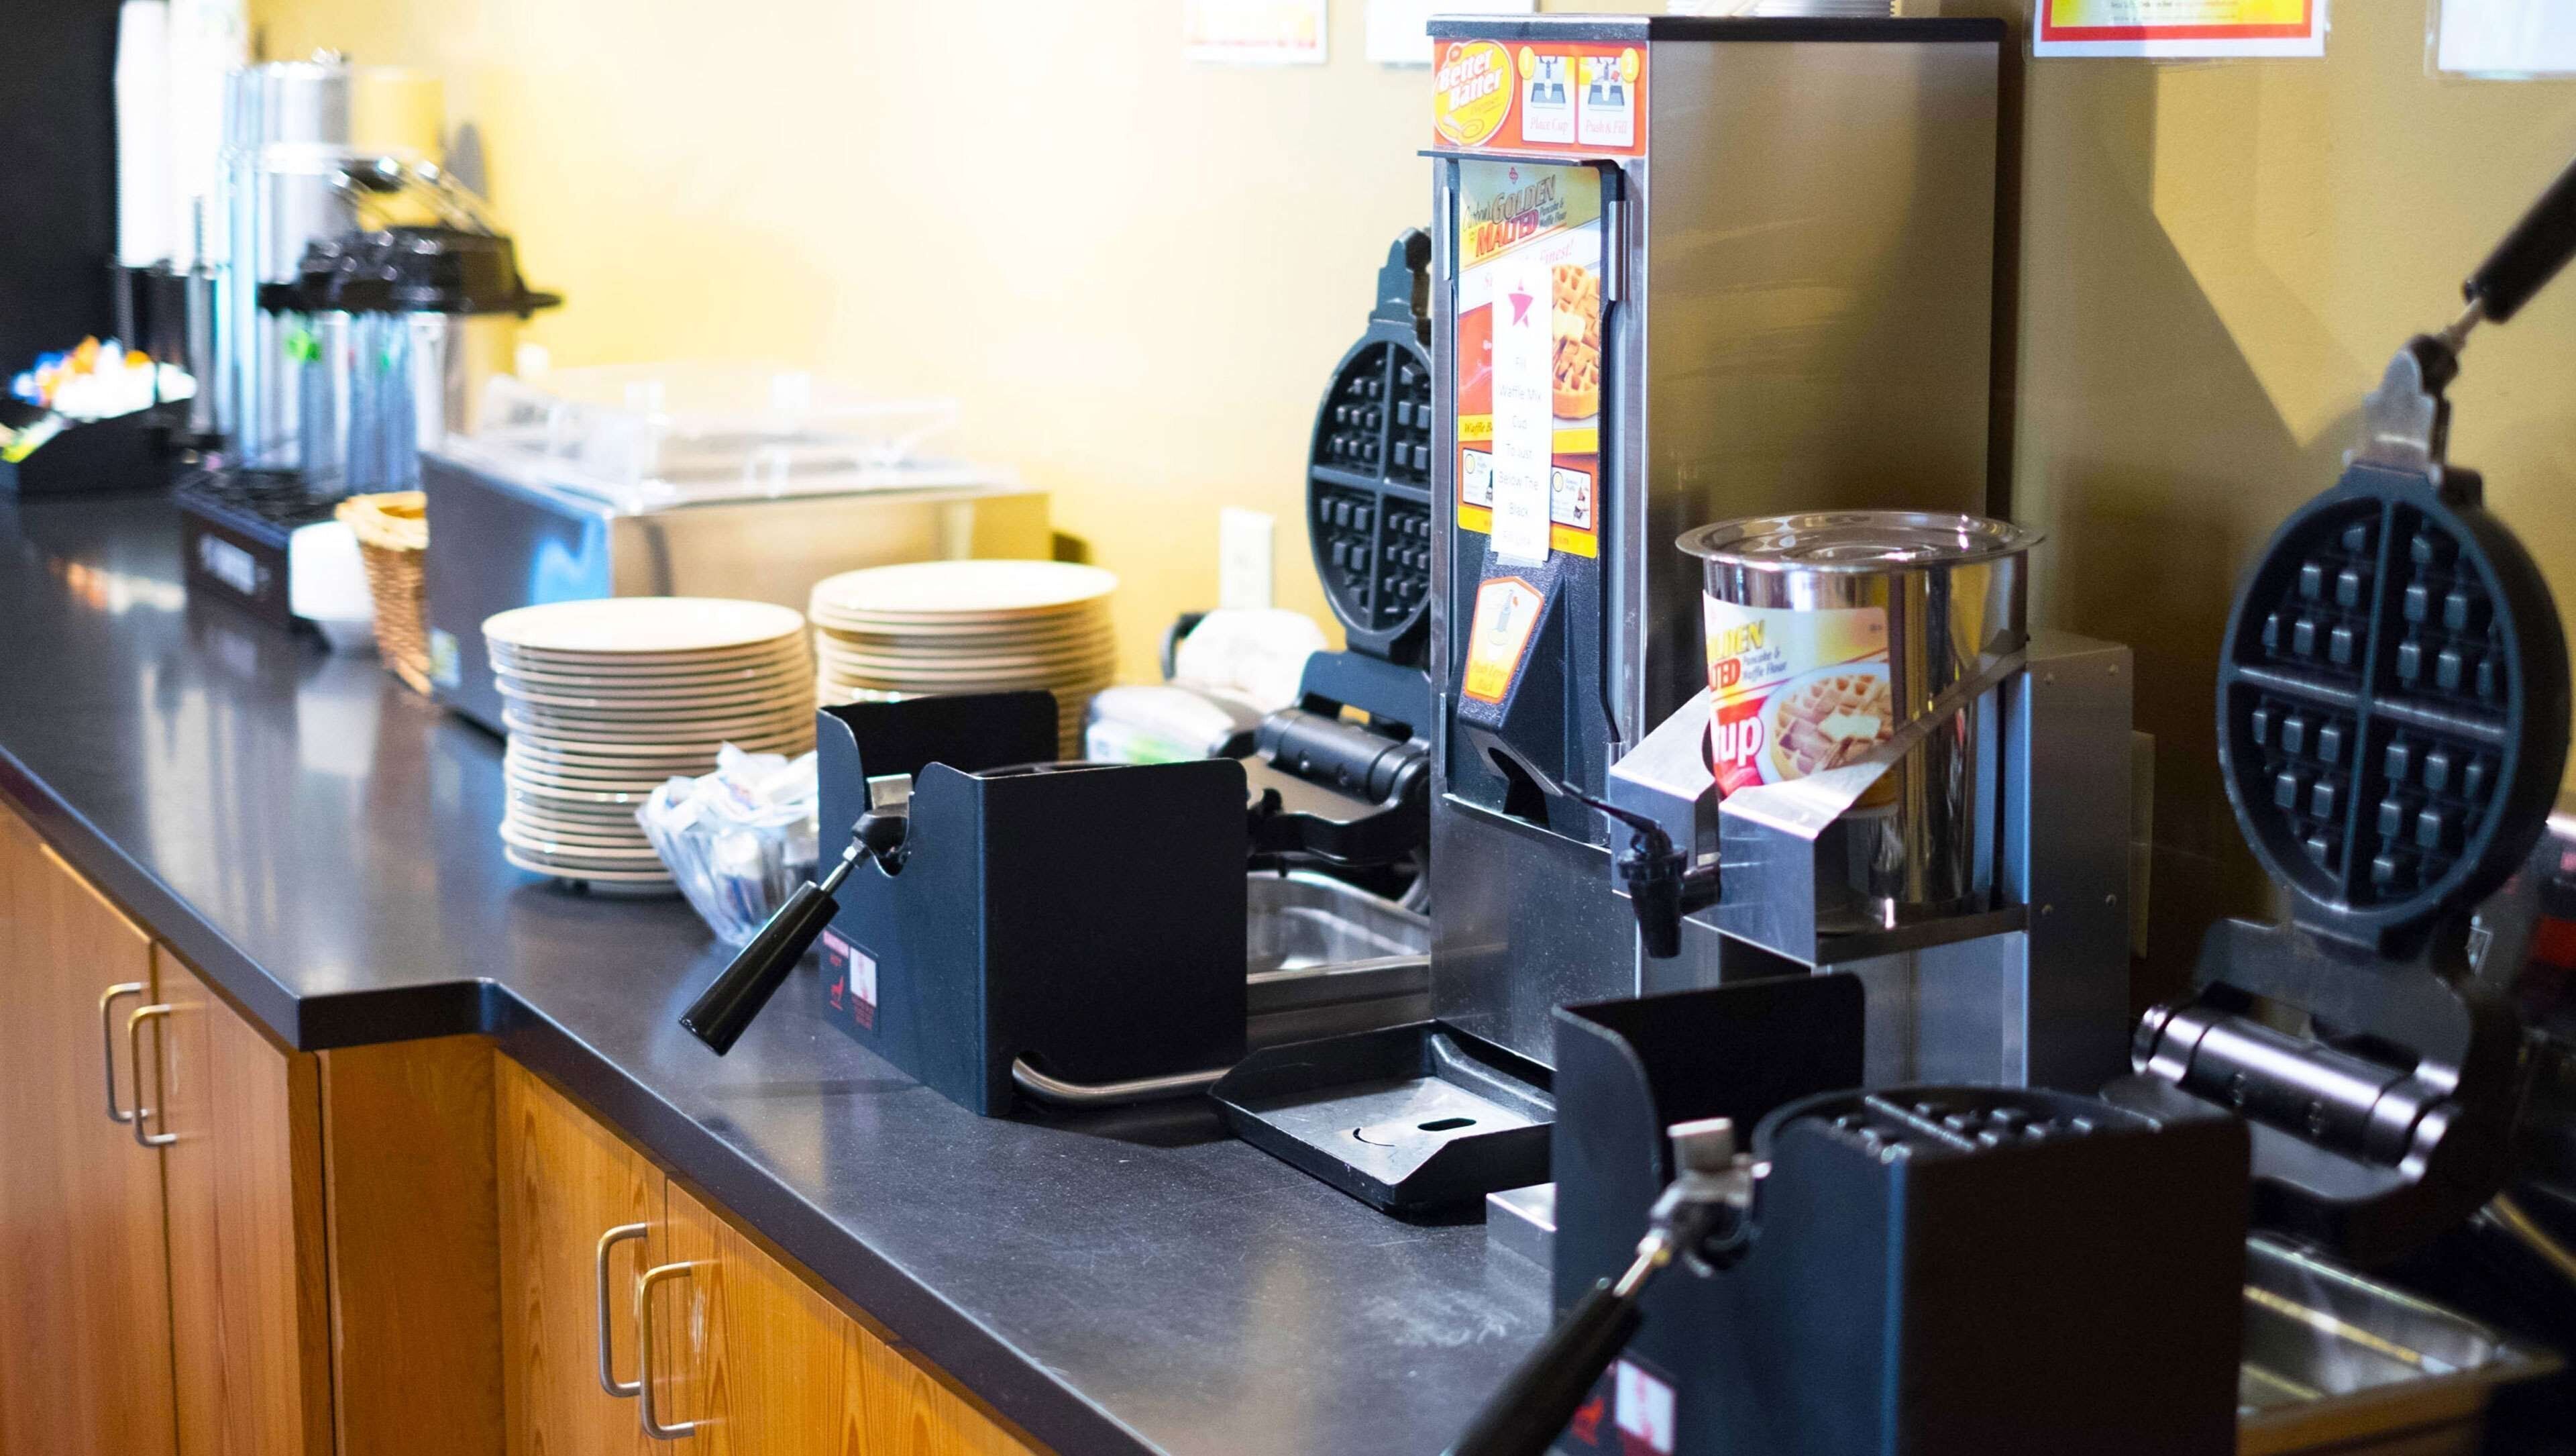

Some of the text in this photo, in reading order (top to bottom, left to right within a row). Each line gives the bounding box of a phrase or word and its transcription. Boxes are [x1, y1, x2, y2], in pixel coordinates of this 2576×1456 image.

[1491, 174, 1556, 224] GOLDEN
[1475, 209, 1540, 257] MALTED
[1499, 384, 1525, 401] Waffle
[1464, 421, 1485, 435] Waffle
[1498, 470, 1539, 492] Below The
[1509, 502, 1528, 518] Black
